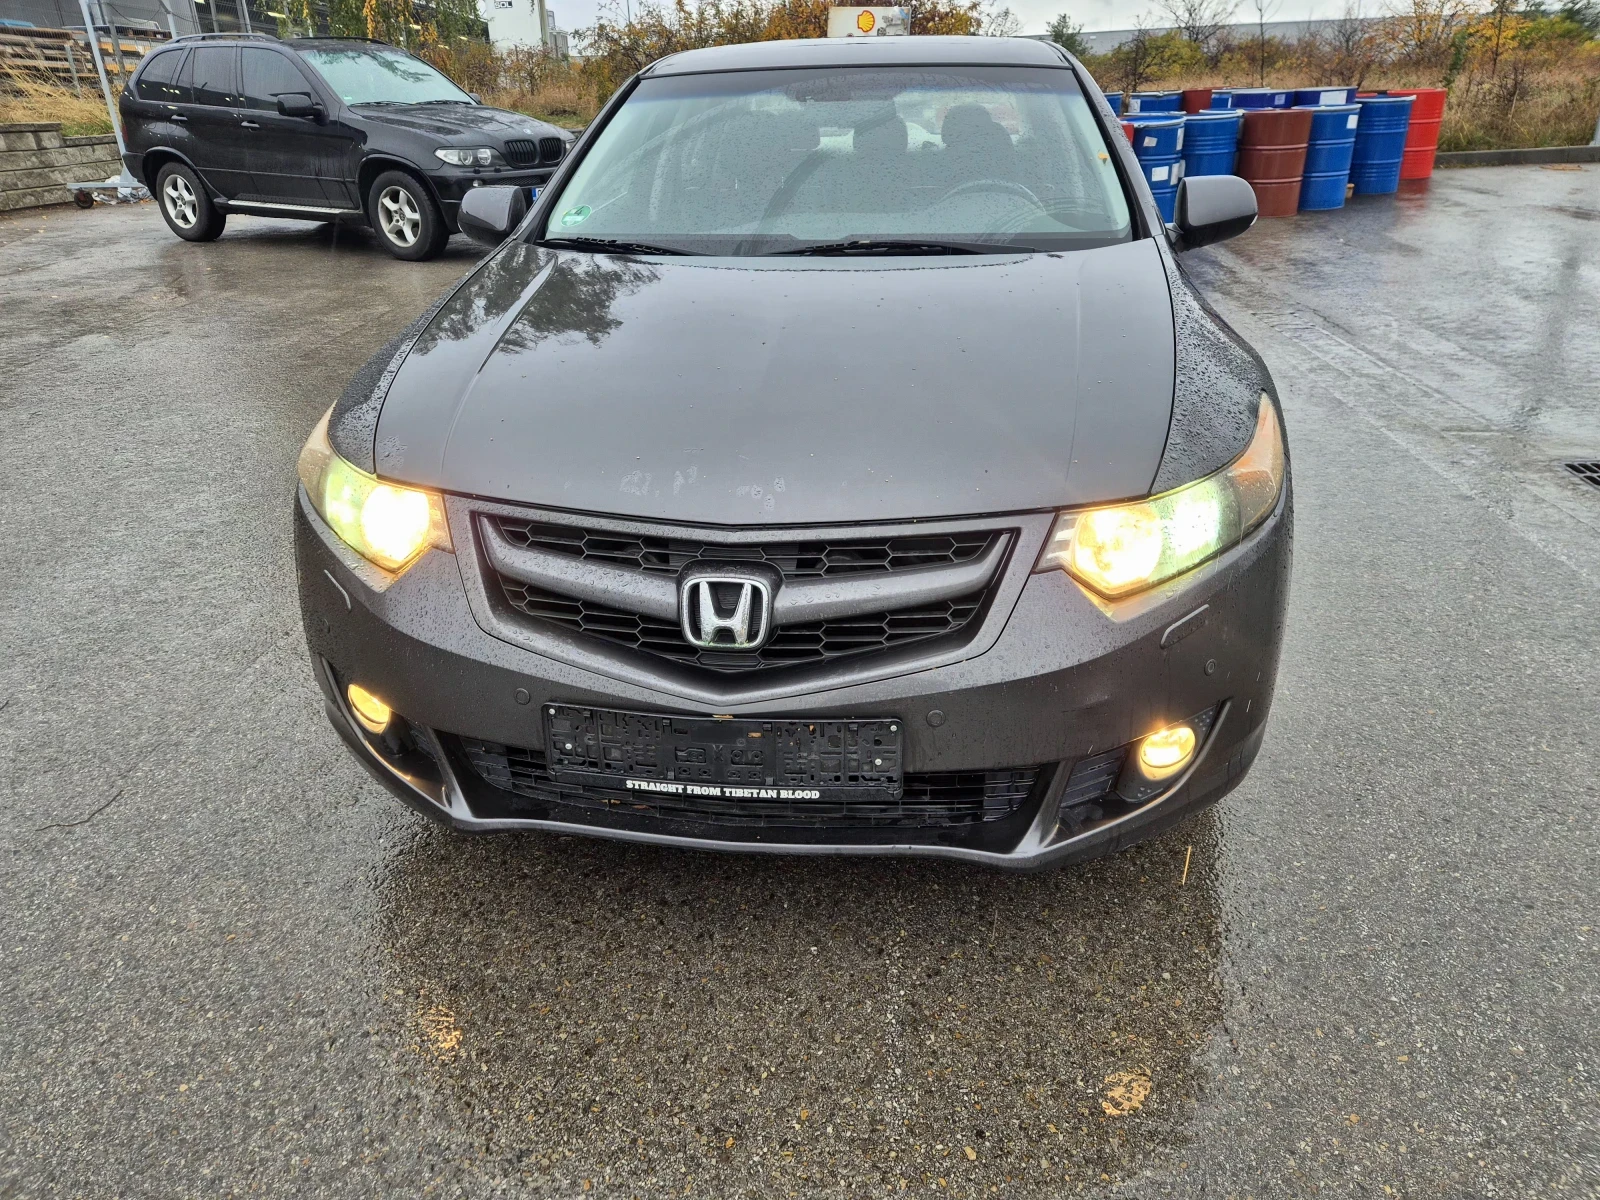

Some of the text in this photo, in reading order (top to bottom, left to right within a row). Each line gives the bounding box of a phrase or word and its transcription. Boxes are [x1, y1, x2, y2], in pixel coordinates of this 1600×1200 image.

[626, 780, 820, 799] STRAIGHT FROM TIBETAN BLOOD
